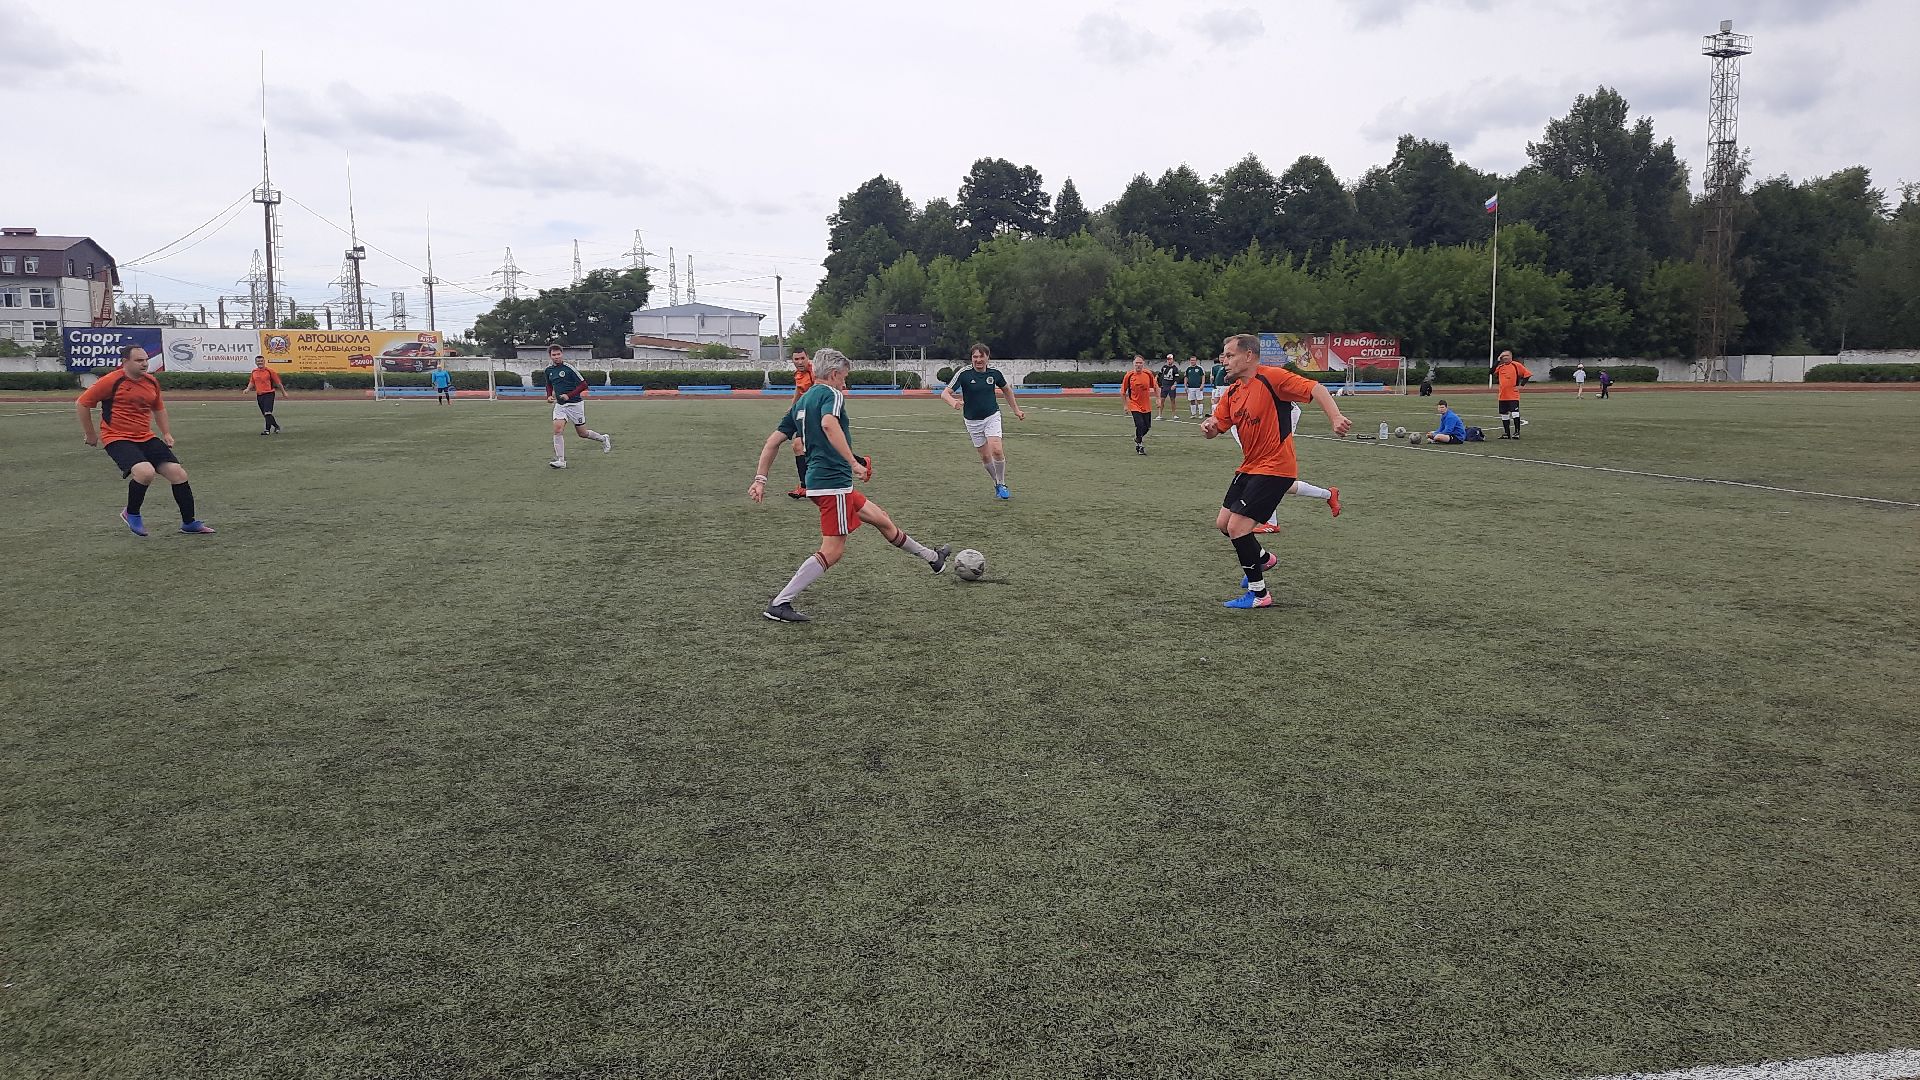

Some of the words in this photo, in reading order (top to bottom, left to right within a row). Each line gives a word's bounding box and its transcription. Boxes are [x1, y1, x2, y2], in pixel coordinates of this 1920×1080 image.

[70, 331, 122, 345] Спорт
[297, 334, 370, 343] АВТОШКОЛА
[1333, 337, 1341, 346] Я
[1344, 336, 1395, 347] выбираю
[202, 343, 253, 352] ГРАНИТ
[1361, 348, 1395, 357] спорт!
